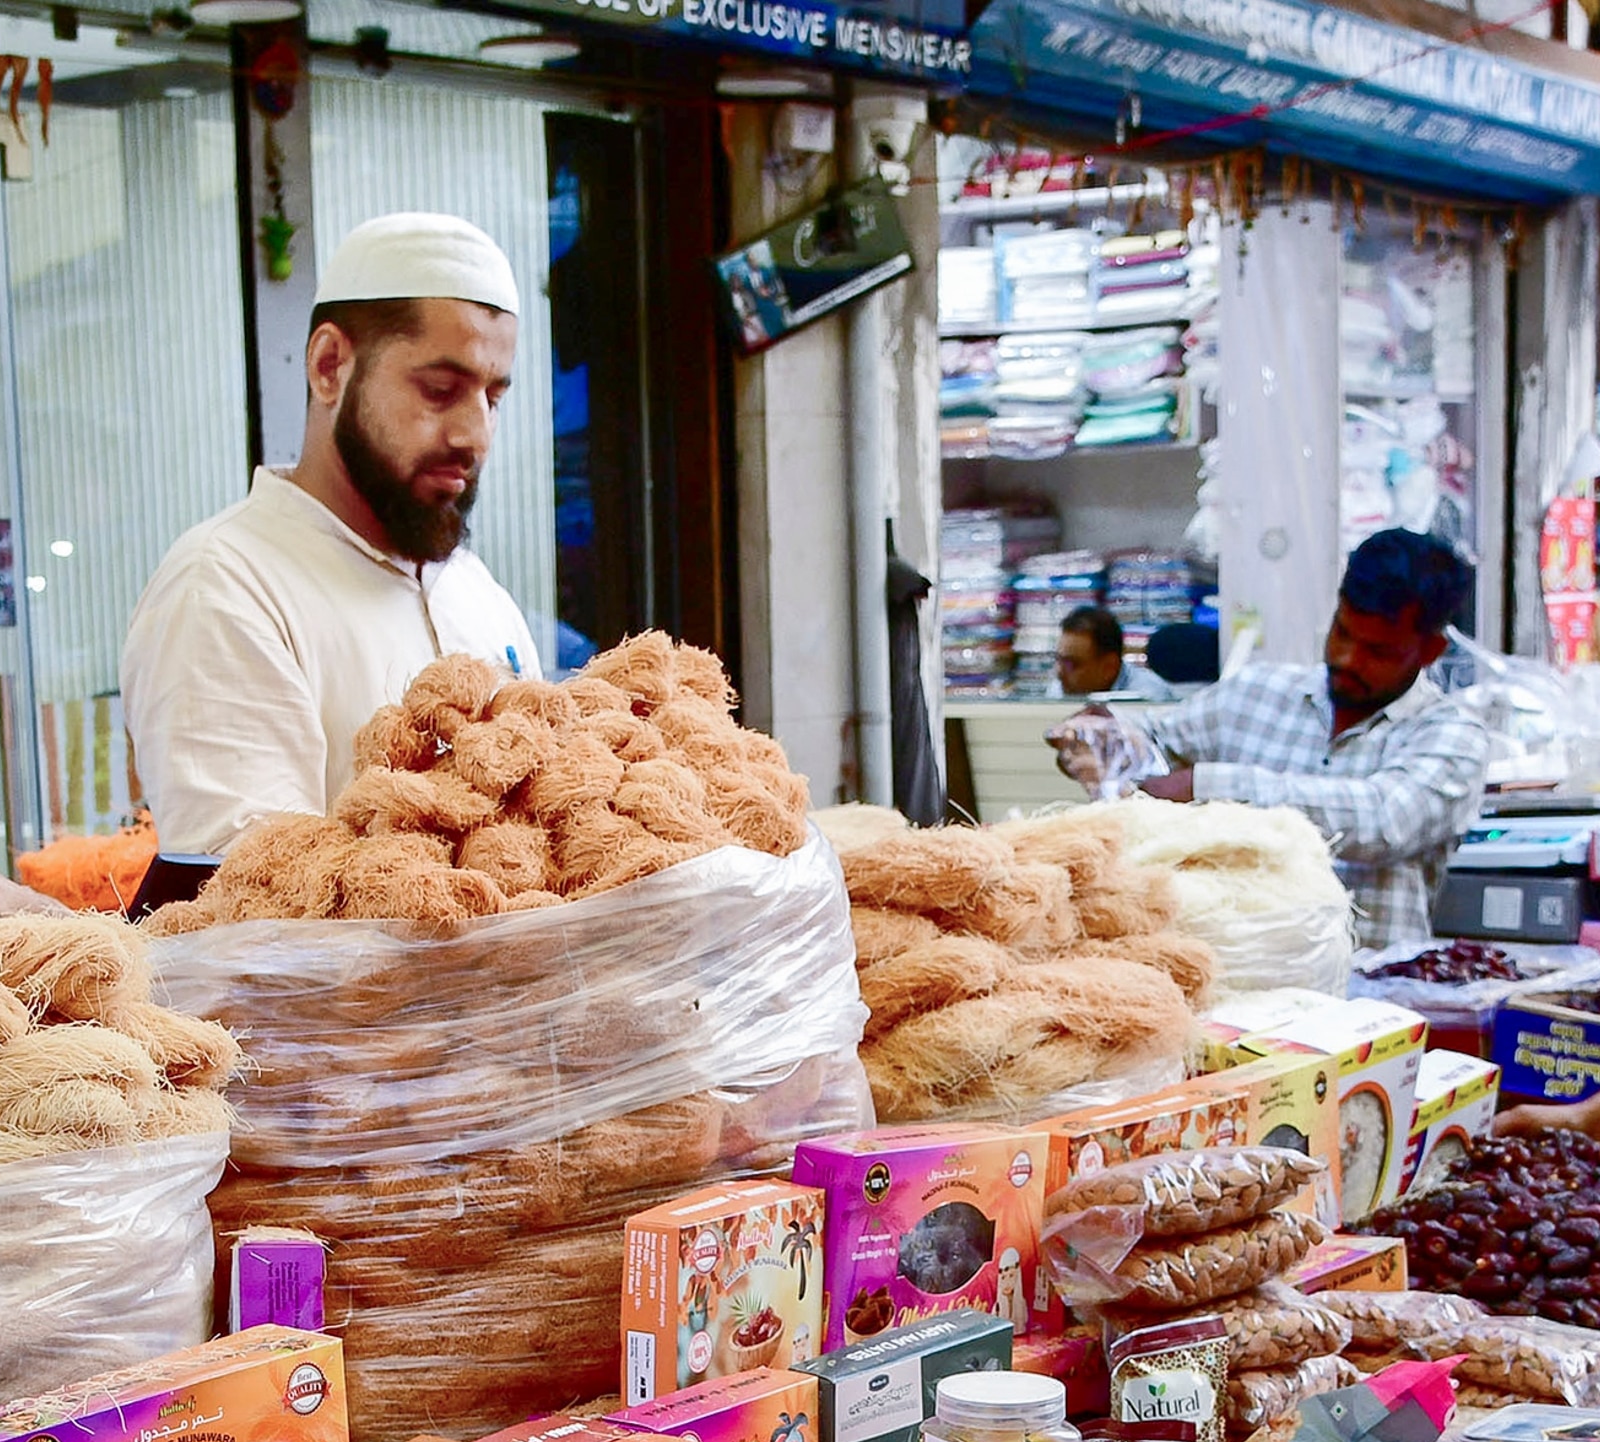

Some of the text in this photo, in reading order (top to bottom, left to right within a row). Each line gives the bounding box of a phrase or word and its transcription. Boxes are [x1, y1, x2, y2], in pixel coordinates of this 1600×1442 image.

[683, 0, 972, 72] EXCLUSIVE MENSWEAR
[848, 1322, 956, 1362] MARYAM DATES
[288, 1380, 327, 1404] QUALITY
[1125, 1390, 1200, 1420] Natural
[158, 1395, 197, 1421] Mulla-G
